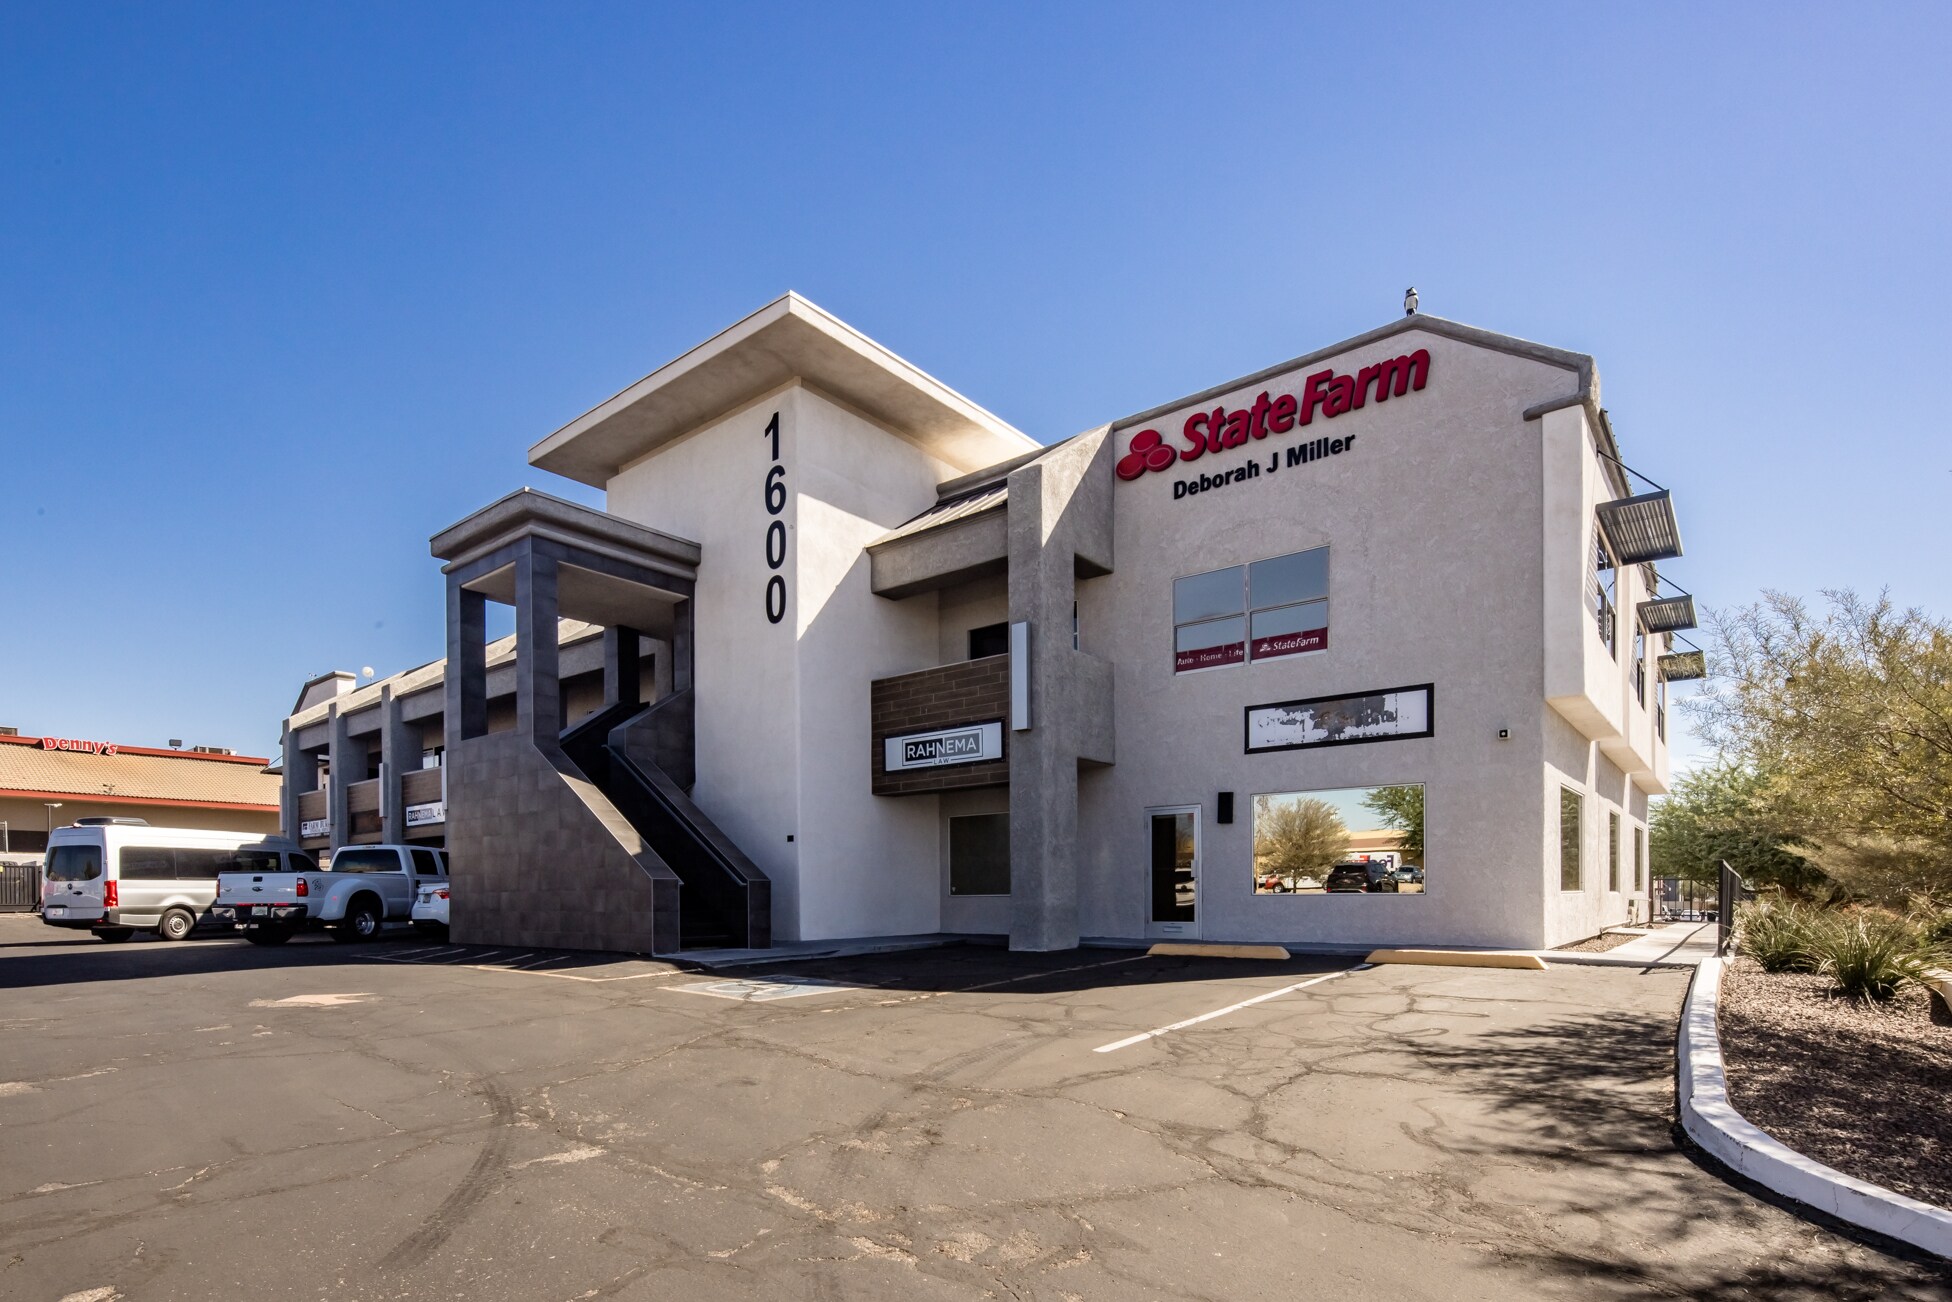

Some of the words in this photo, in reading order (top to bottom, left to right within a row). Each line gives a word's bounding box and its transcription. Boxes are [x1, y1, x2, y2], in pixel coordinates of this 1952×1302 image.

[1173, 460, 1260, 500] Deborah
[1266, 452, 1279, 474] J
[1287, 434, 1356, 468] Miller
[764, 411, 786, 624] 1600
[1200, 653, 1222, 662] Home
[1229, 649, 1244, 657] Life
[42, 737, 118, 756] Denny's
[907, 737, 977, 759] RAHNEMA
